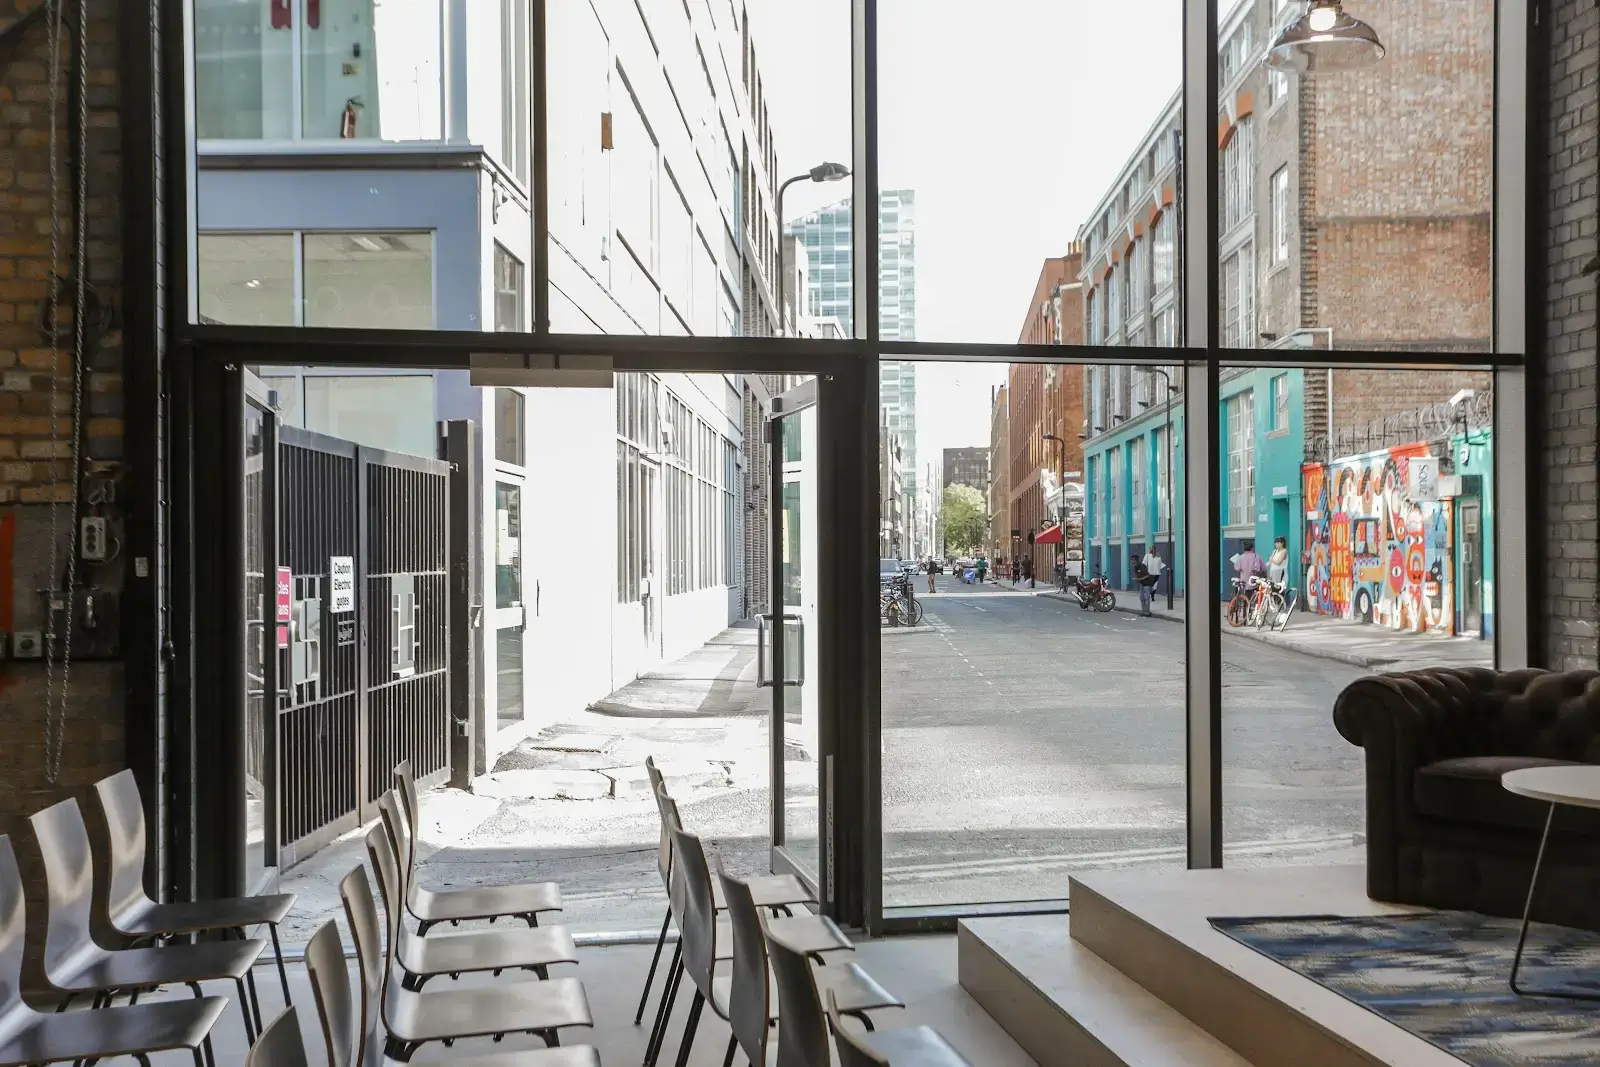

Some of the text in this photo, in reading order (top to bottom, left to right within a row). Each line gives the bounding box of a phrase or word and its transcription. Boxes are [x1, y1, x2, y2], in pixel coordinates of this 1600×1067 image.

[1331, 523, 1350, 547] YOU
[334, 562, 351, 575] Caution
[1331, 550, 1349, 574] ARE
[334, 578, 351, 591] Electric
[1330, 576, 1350, 602] HERE
[336, 597, 350, 609] gates
